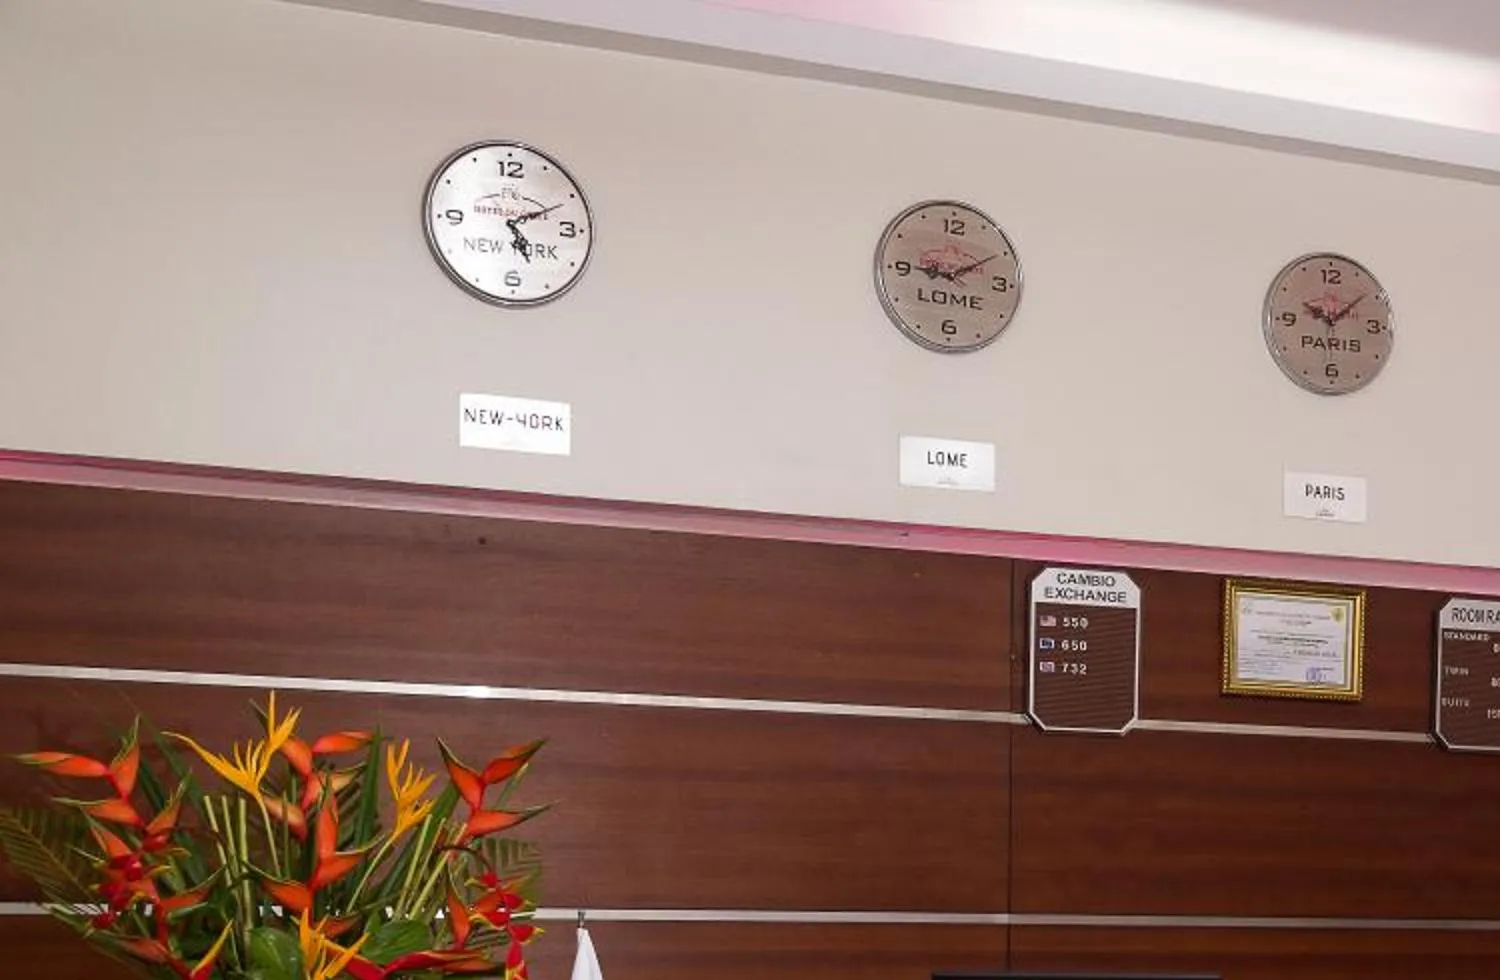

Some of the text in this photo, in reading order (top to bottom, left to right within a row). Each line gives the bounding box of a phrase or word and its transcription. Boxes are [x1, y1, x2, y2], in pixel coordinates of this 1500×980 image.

[497, 160, 524, 179] 12
[445, 208, 464, 226] 9
[559, 221, 577, 239] 3
[943, 219, 966, 237] 12
[463, 236, 503, 255] NEW
[895, 261, 911, 277] 9
[1320, 269, 1341, 285] 12
[504, 270, 522, 288] 6
[991, 275, 1007, 293] 3
[917, 287, 985, 311] LOME
[941, 319, 957, 336] 6
[1281, 311, 1297, 327] 9
[1366, 319, 1381, 335] 3
[1301, 335, 1361, 353] PARIS
[1325, 363, 1339, 378] 6
[926, 450, 968, 469] LOME
[1304, 483, 1345, 501] PARIS
[1056, 572, 1116, 588] CAMBIO
[1043, 587, 1127, 603] EXCHANGE
[1061, 616, 1089, 629] 550
[1451, 607, 1486, 623] ROOM
[1061, 639, 1088, 652] 650
[1061, 662, 1088, 676] 732
